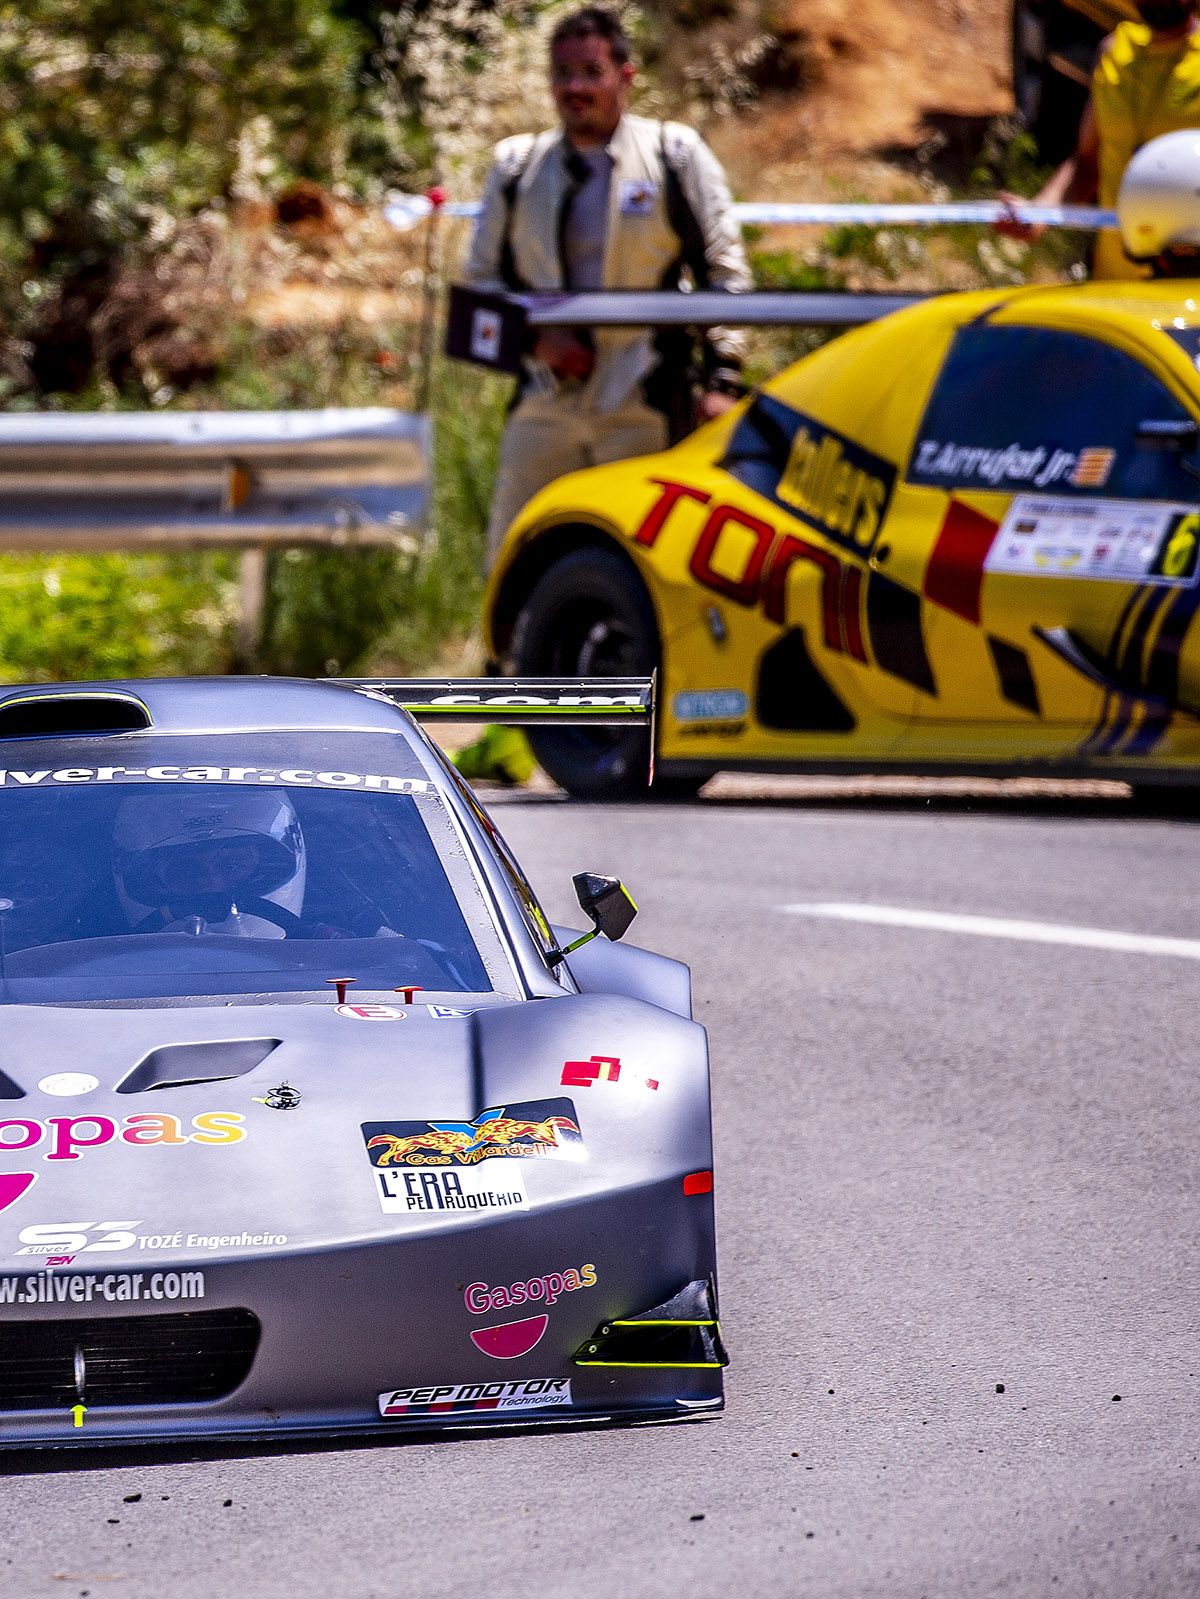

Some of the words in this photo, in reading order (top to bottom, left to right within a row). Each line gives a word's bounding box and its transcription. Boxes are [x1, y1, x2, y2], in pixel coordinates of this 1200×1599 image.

[406, 1153, 452, 1165] Gas
[138, 1231, 181, 1249] TOZÉ
[187, 1231, 287, 1249] Engenheiro
[464, 1263, 597, 1314] Gasopas
[388, 1387, 452, 1405] PEP
[456, 1379, 569, 1400] MOTOR
[501, 1394, 567, 1407] Technology
